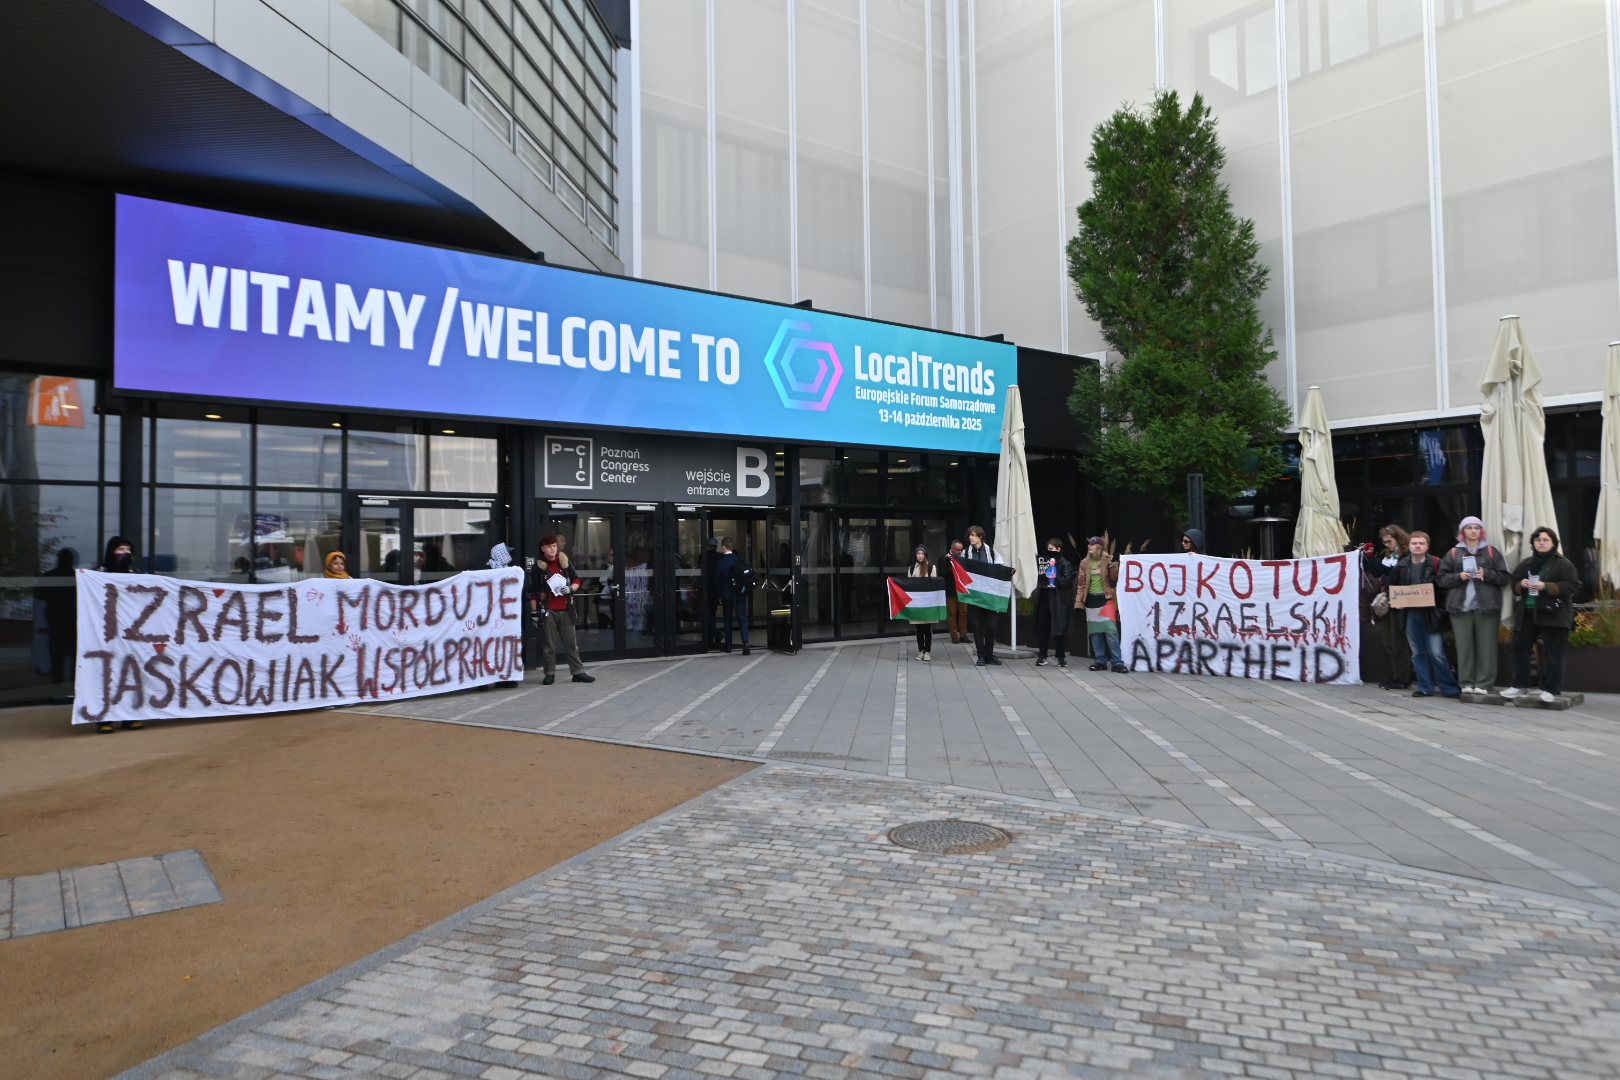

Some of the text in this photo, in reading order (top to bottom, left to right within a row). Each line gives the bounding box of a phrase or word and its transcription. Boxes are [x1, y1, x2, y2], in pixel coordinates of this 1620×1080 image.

[691, 332, 741, 386] TO
[854, 345, 996, 397] LocalTrends
[855, 386, 996, 415] Europejskie Forum Samorządowe
[878, 408, 983, 431] 13-14 października 2025
[600, 446, 640, 459] Poznań
[600, 459, 650, 472] Congress
[600, 471, 637, 484] Center
[685, 468, 731, 484] wejście
[736, 446, 771, 498] B
[686, 484, 730, 496] entrance
[1124, 554, 1348, 600] BOJKOTUJ
[103, 577, 520, 645] IZRAEL MORDUJE
[1152, 600, 1344, 638] IZRAELSKI
[1130, 637, 1346, 684] APARTHEID
